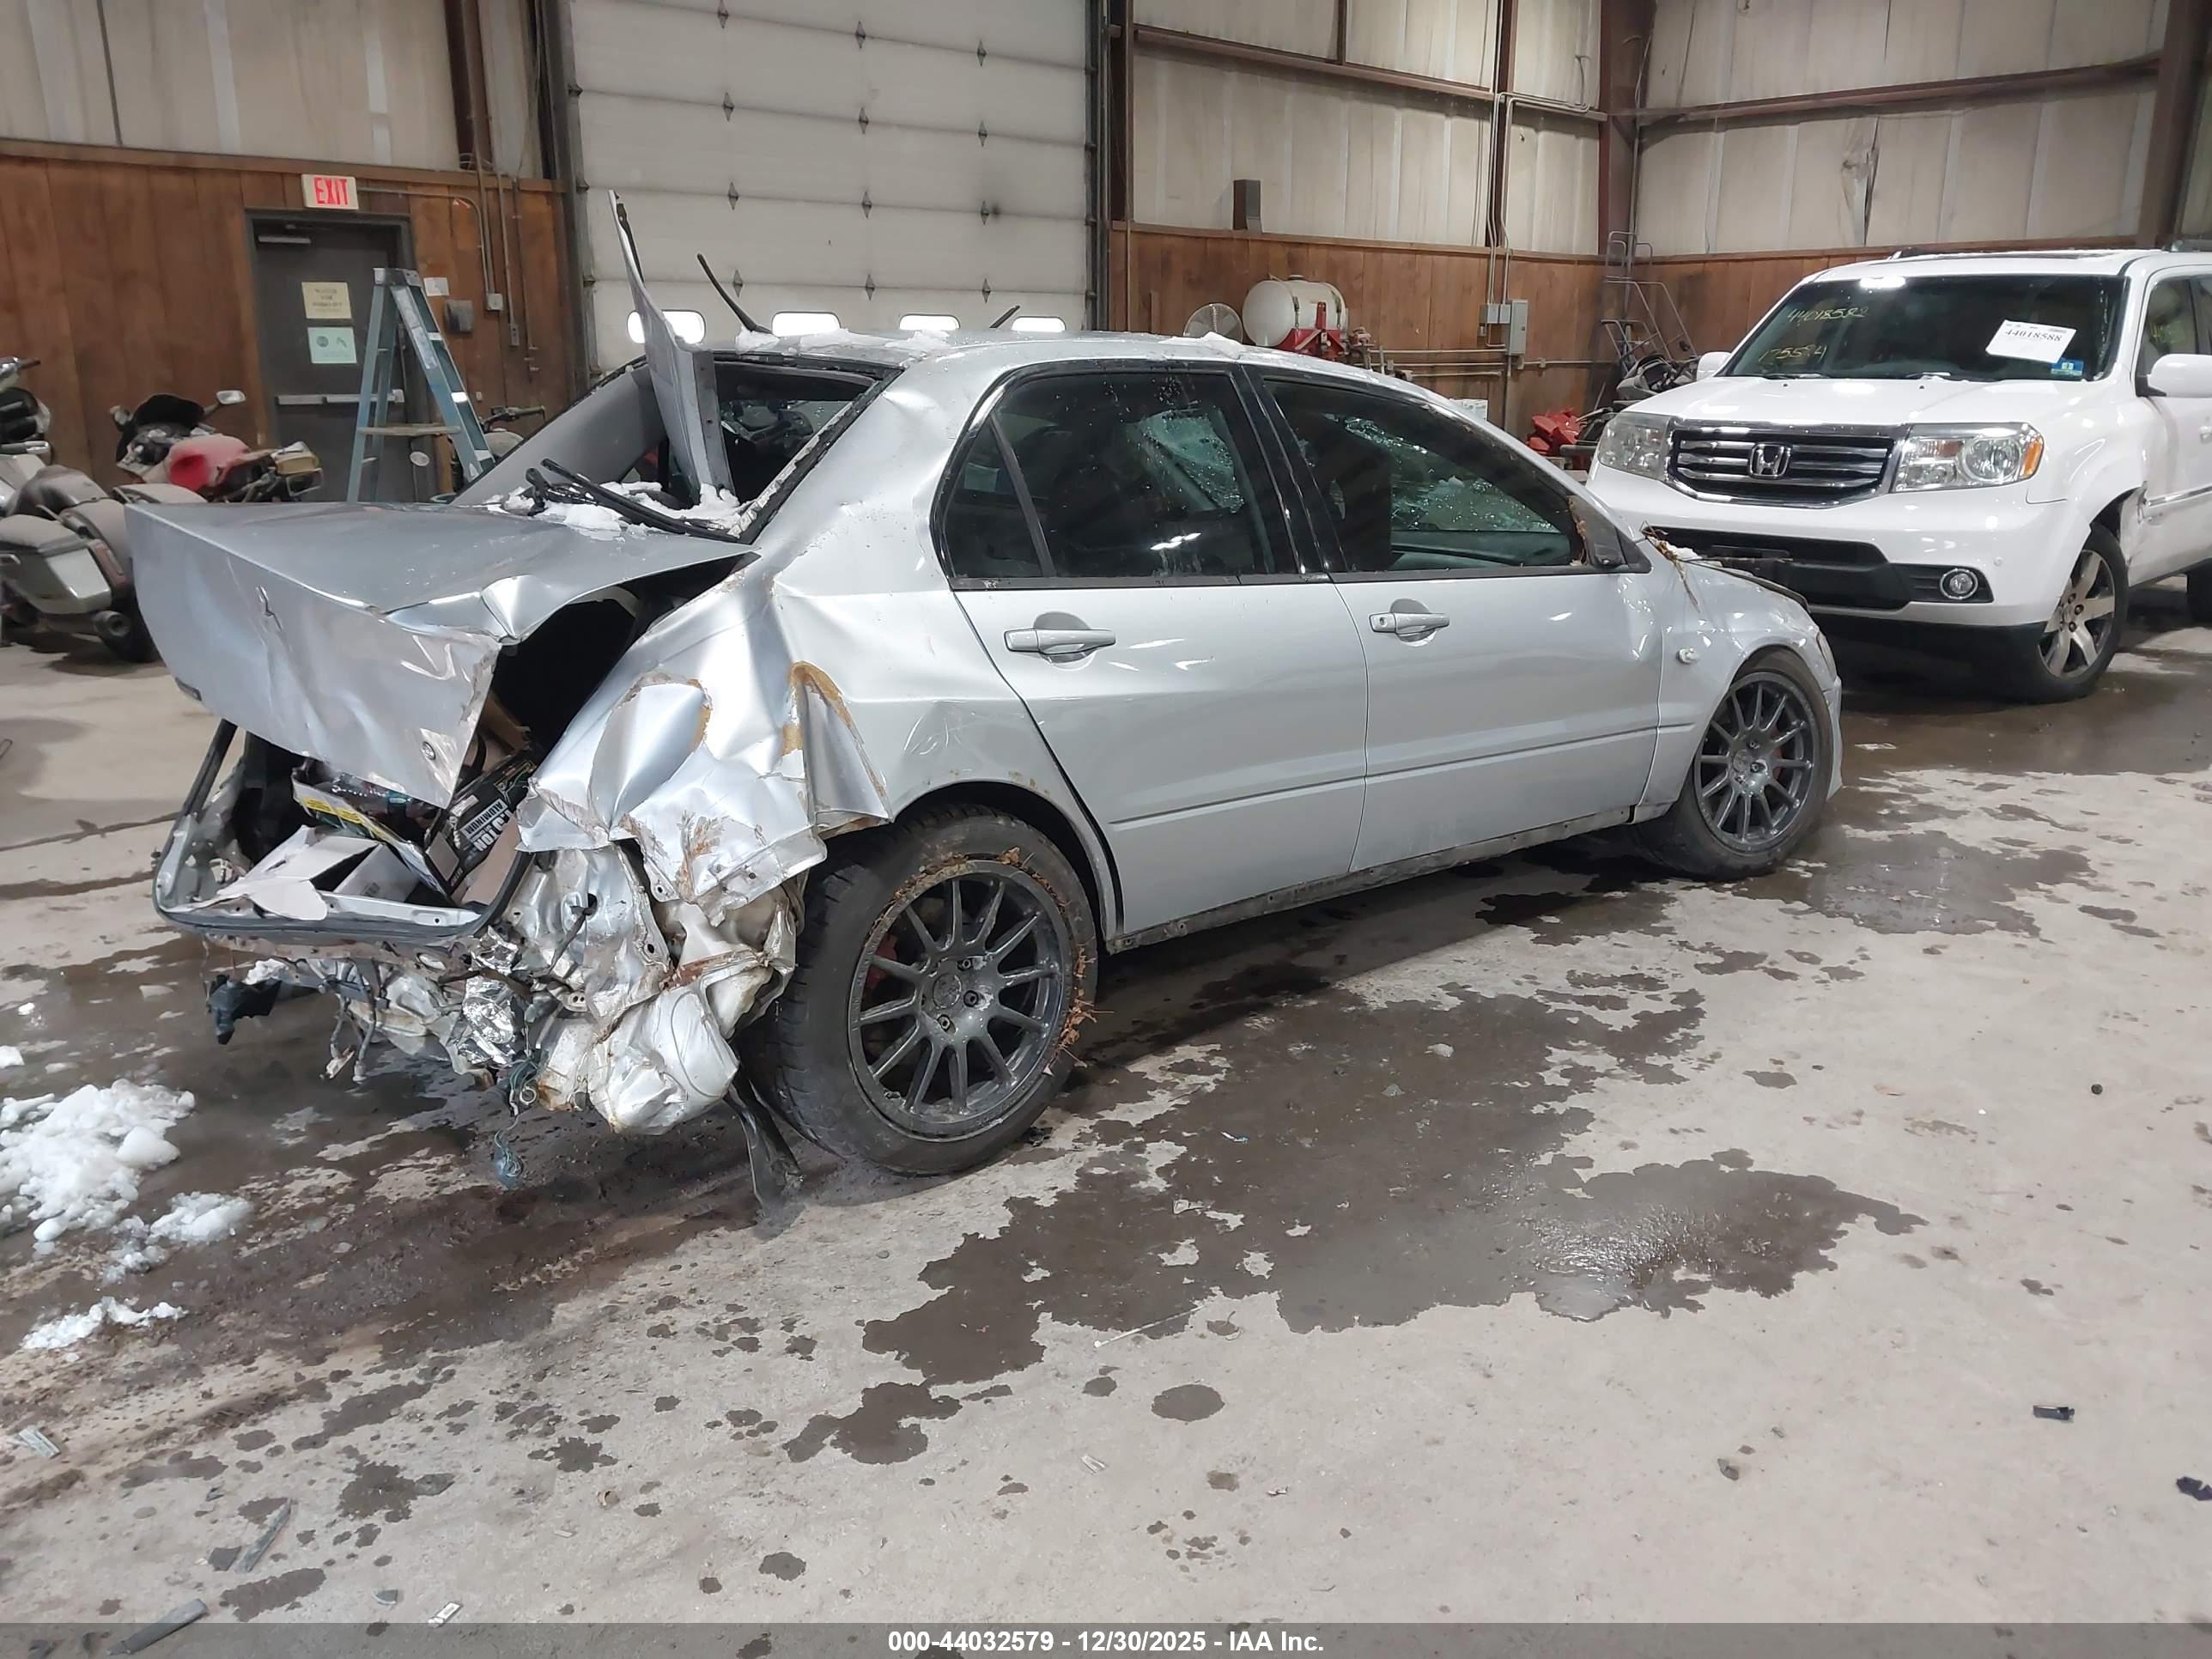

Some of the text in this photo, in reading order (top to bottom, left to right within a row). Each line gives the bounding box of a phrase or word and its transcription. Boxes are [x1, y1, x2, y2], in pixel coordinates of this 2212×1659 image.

[313, 177, 348, 205] EXIT
[2005, 329, 2063, 342] 44018588
[464, 799, 504, 835] ALUMINUM
[473, 825, 500, 852] TON
